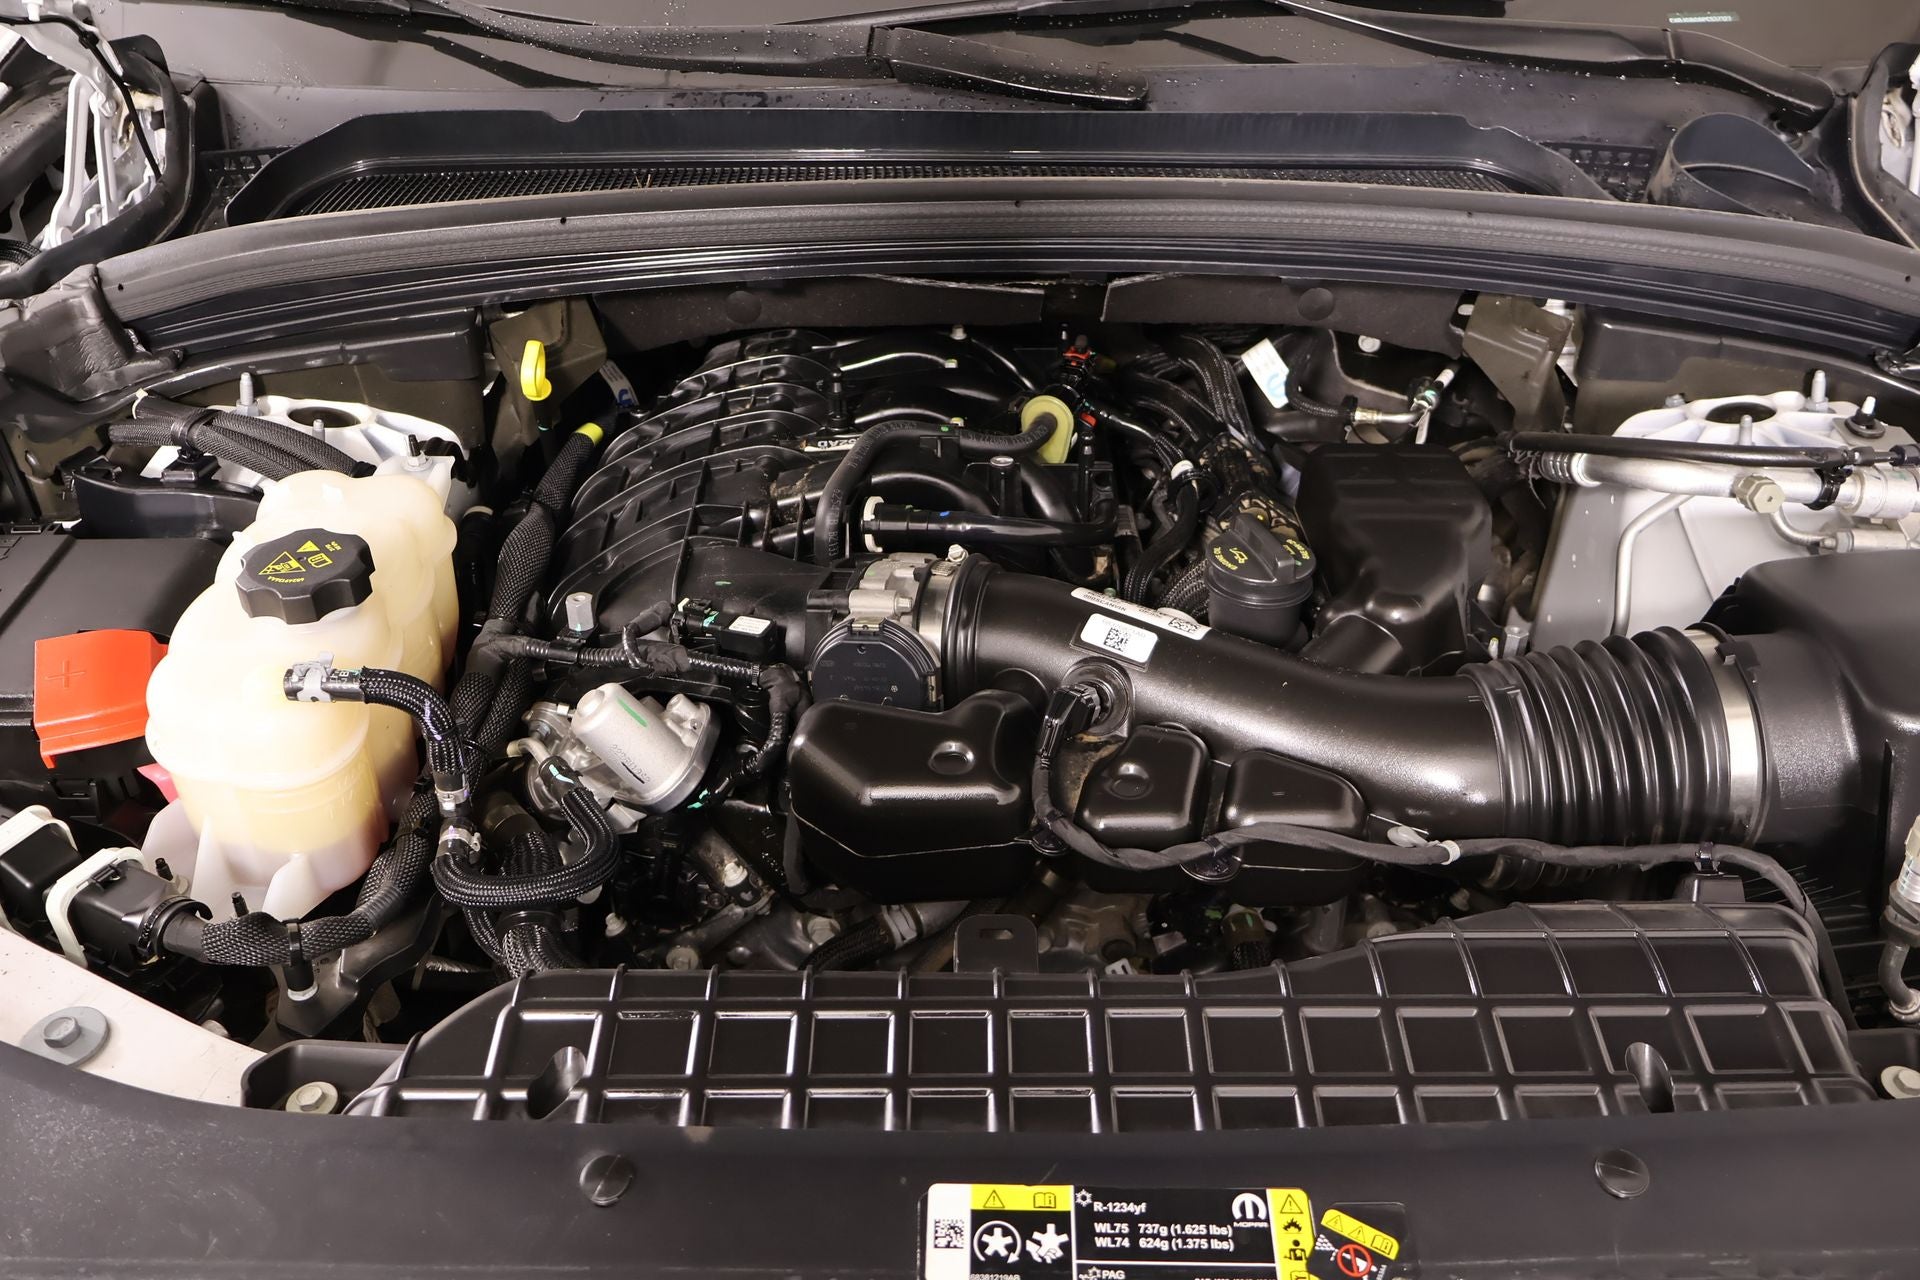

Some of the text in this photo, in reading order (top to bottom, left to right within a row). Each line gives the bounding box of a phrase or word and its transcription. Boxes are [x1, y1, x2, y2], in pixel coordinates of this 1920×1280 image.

[1093, 1202, 1147, 1215] R-1234yf
[1094, 1222, 1233, 1238] WL75 737g (1.625 lbs)
[1094, 1237, 1234, 1252] WL74 624g (1.375 lbs)
[1102, 1269, 1126, 1280] PAG
